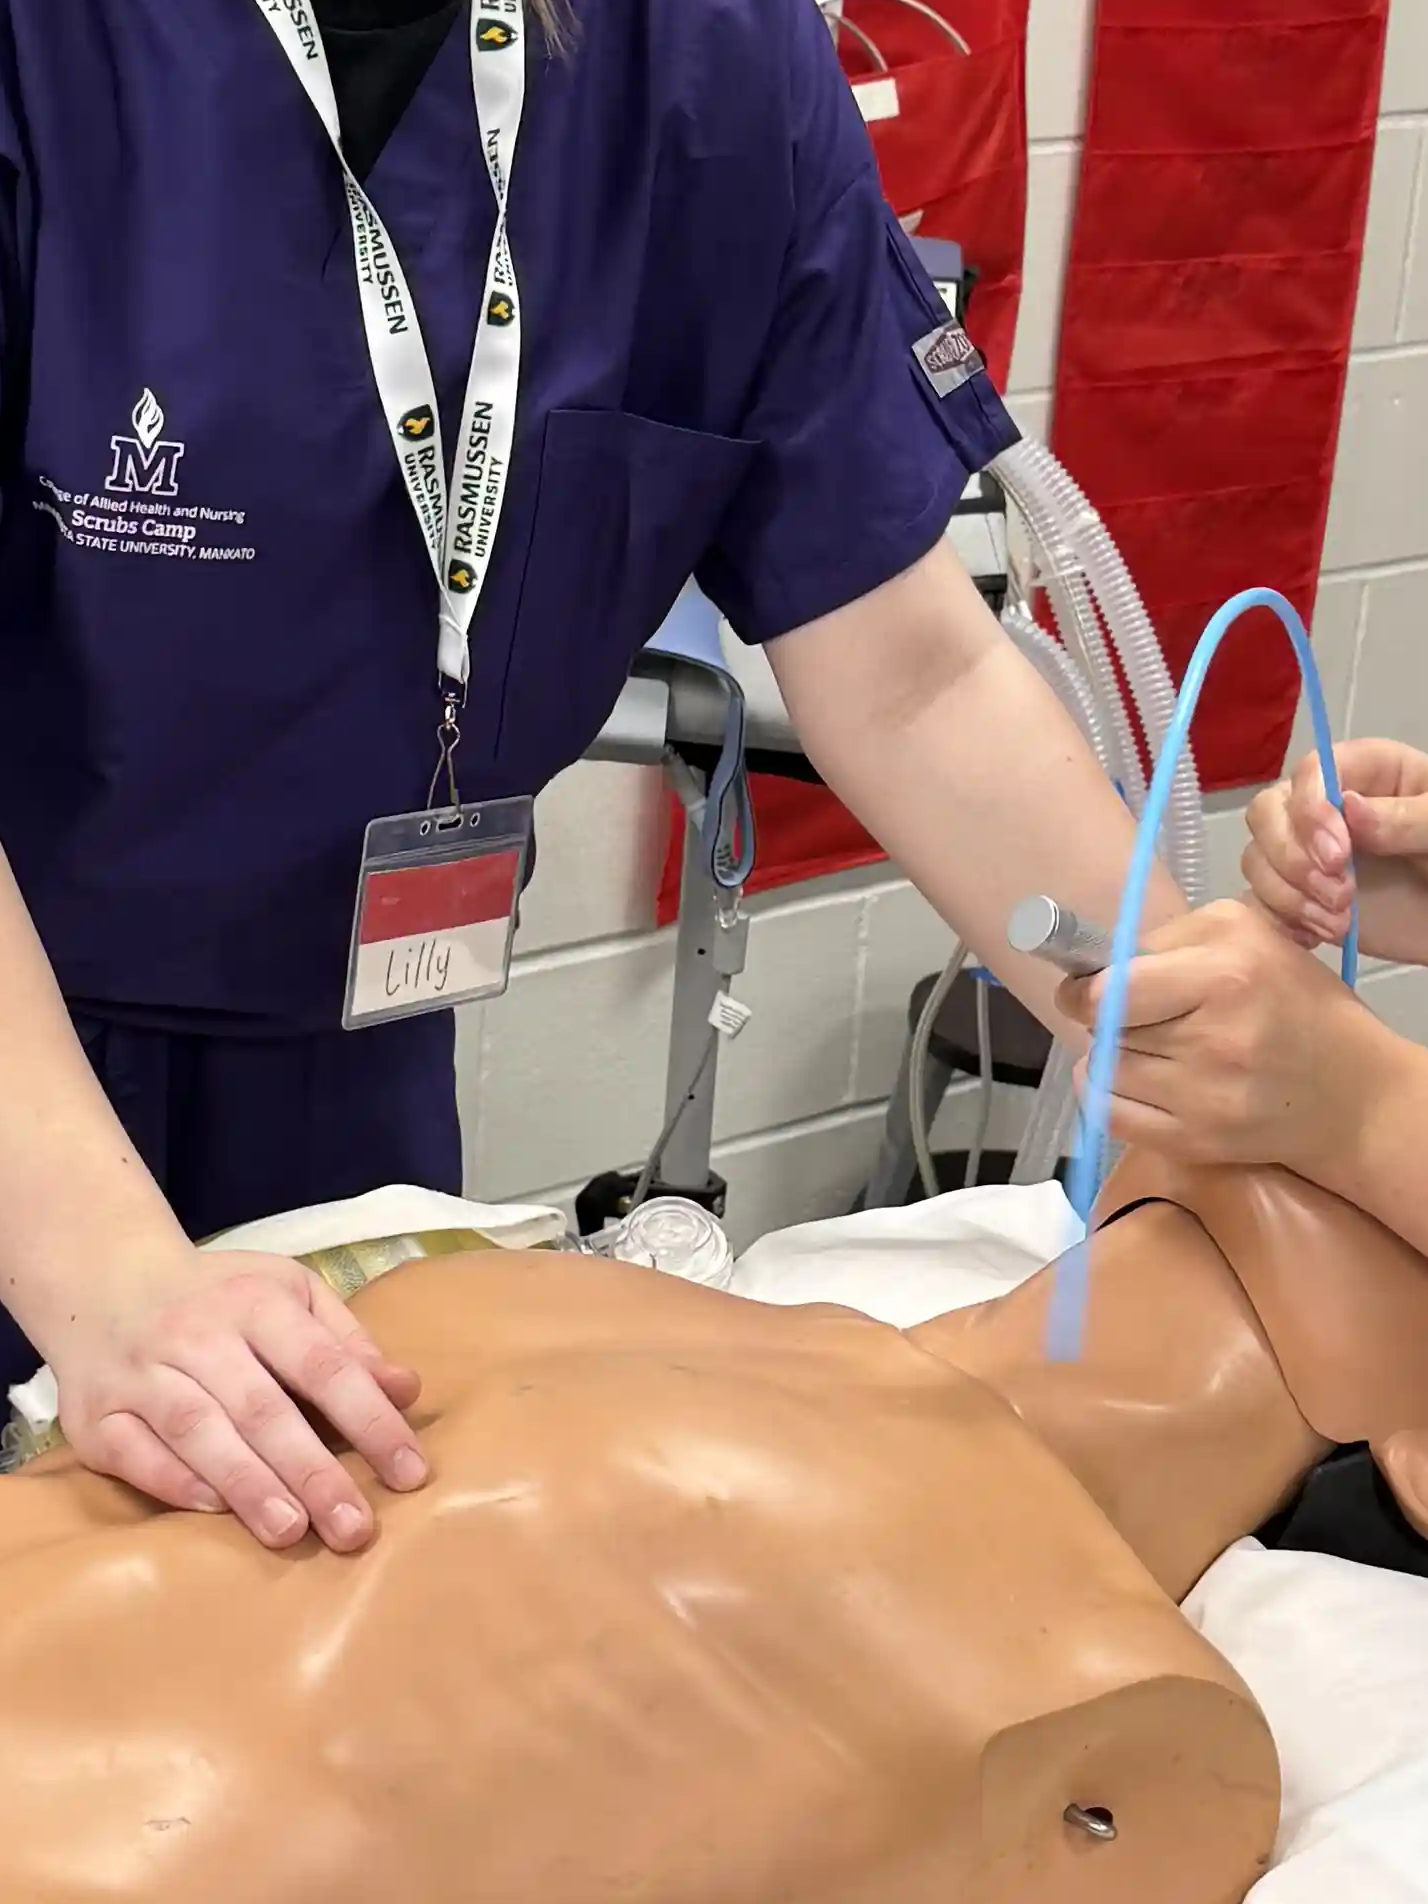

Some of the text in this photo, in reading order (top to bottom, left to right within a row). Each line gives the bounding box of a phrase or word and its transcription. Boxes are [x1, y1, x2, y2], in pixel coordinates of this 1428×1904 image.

[104, 434, 185, 497] M
[452, 400, 494, 555] RASMUSSEN
[71, 509, 139, 535] Scrubs
[141, 519, 197, 543] Camp
[73, 493, 89, 506] of
[89, 496, 127, 513] Allied
[129, 502, 171, 516] Health
[173, 506, 198, 518] and
[199, 509, 246, 525] Nursing
[474, 456, 505, 558] UNIVERSITY
[75, 533, 256, 561] STATE UNIVERSITY, MANKATO
[384, 937, 451, 997] Lilly
